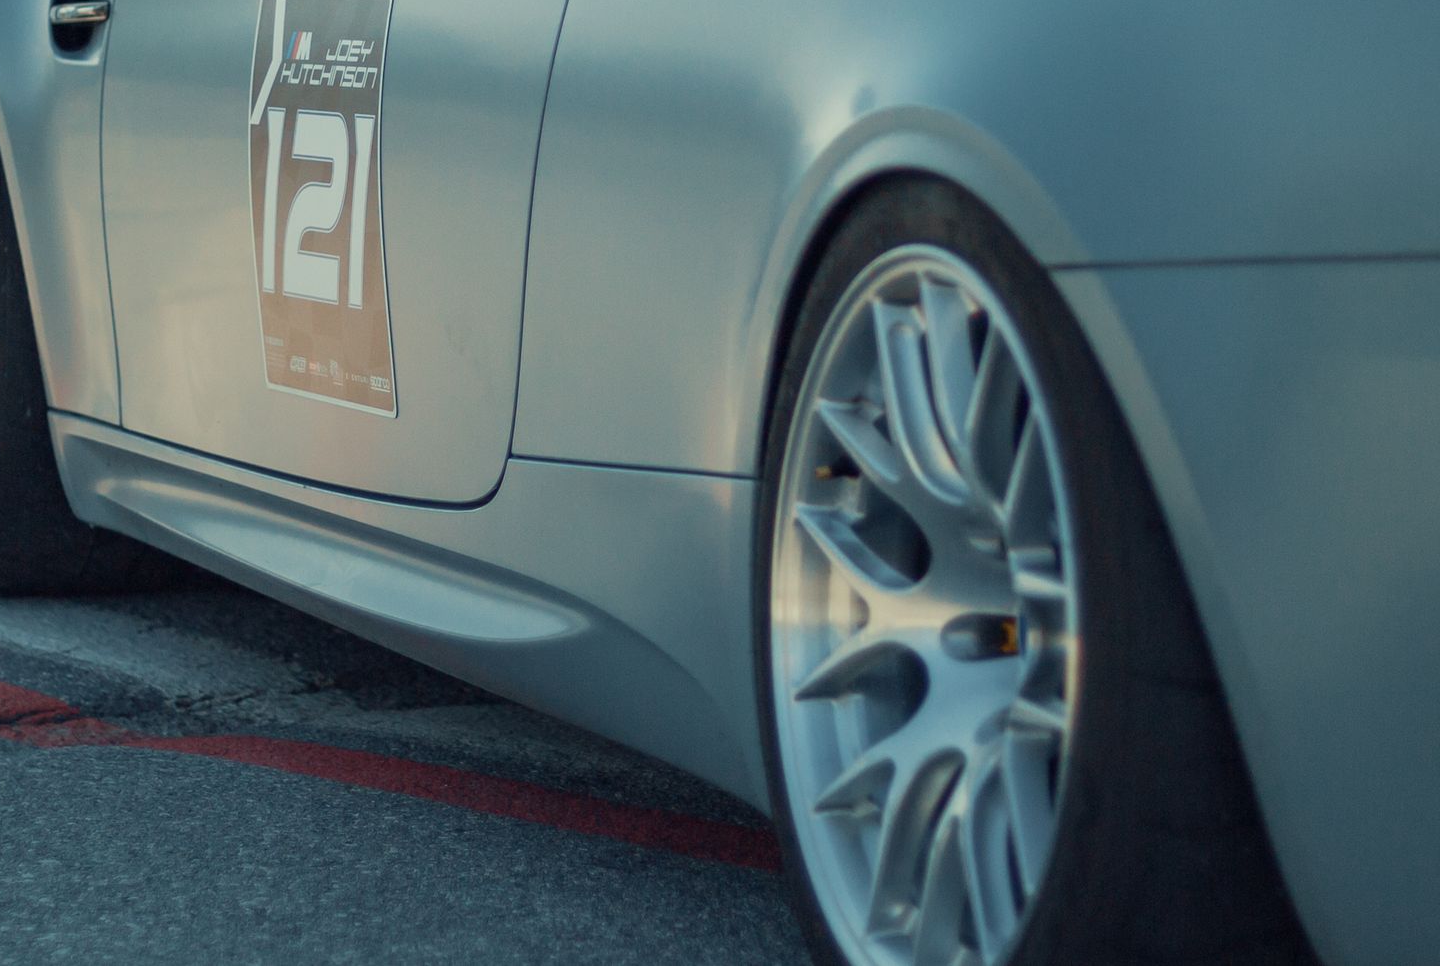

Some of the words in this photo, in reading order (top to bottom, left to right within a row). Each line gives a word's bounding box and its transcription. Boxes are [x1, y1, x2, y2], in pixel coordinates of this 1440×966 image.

[325, 38, 375, 62] JOEY
[279, 63, 378, 89] HUTCHINSON
[262, 106, 376, 310] 121
